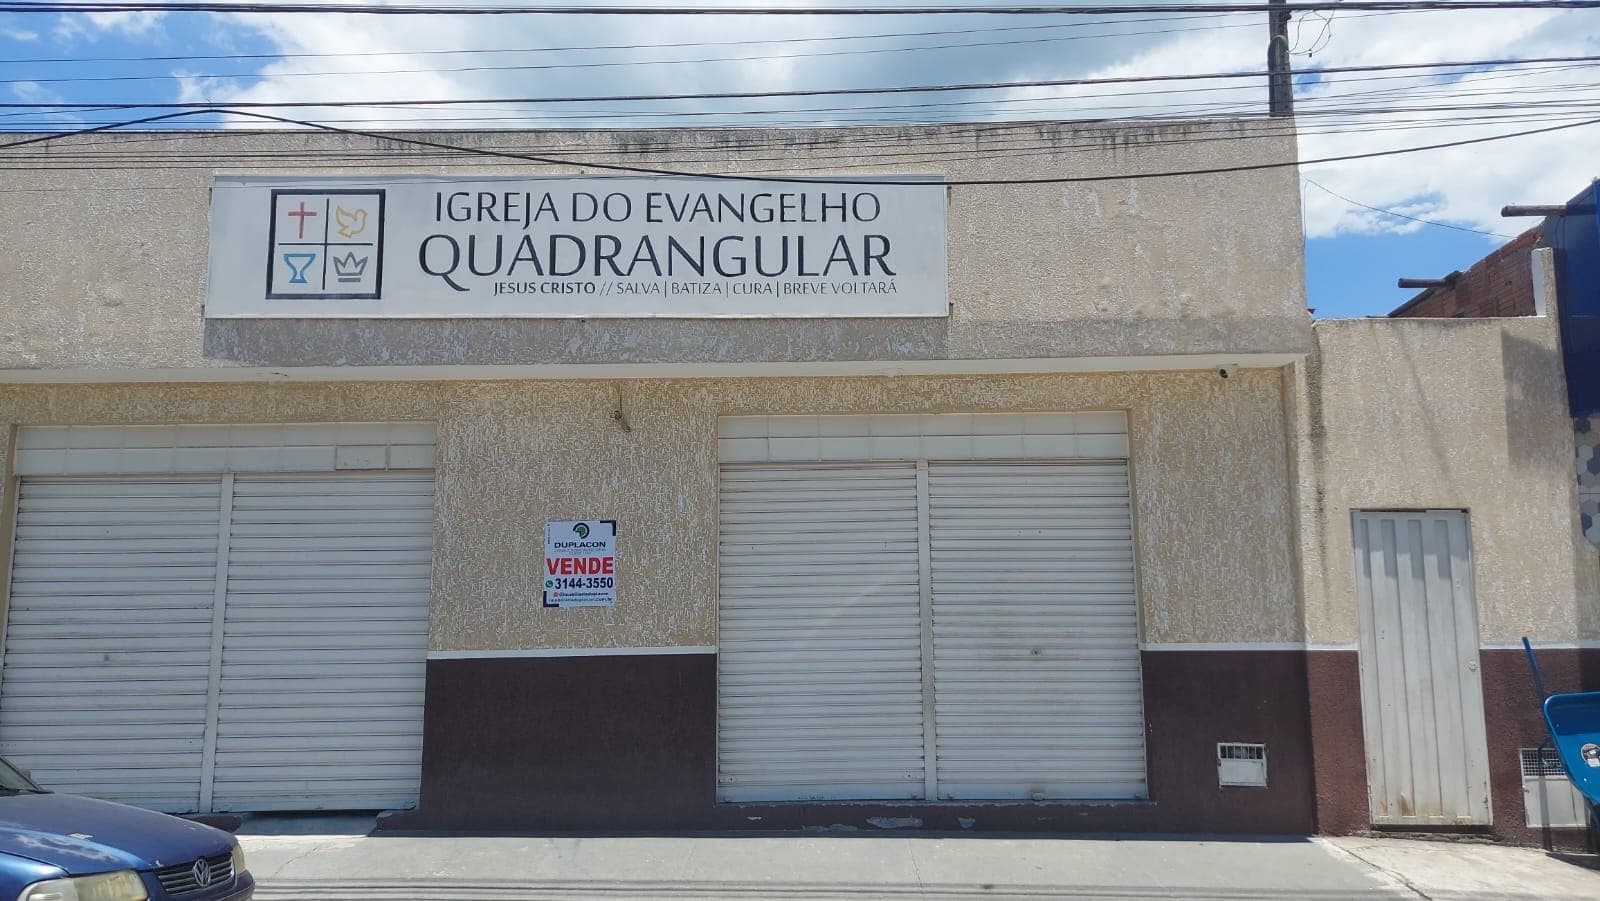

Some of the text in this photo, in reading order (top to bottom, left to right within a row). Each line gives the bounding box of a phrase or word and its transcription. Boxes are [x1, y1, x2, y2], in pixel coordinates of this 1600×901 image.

[435, 191, 881, 229] IGREJA DO EVANGELHO
[418, 234, 897, 293] QUADRANGULAR
[493, 281, 537, 297] JESUS
[540, 281, 596, 297] CRISTO
[616, 281, 661, 296] SALVA
[671, 281, 722, 296] BATIZA
[732, 282, 773, 296] CURA
[783, 282, 828, 296] BREVE
[830, 280, 897, 296] VOLTARÁ
[554, 541, 606, 549] DUPLACON
[547, 557, 614, 576] VENDE
[555, 577, 613, 589] 3144-3550
